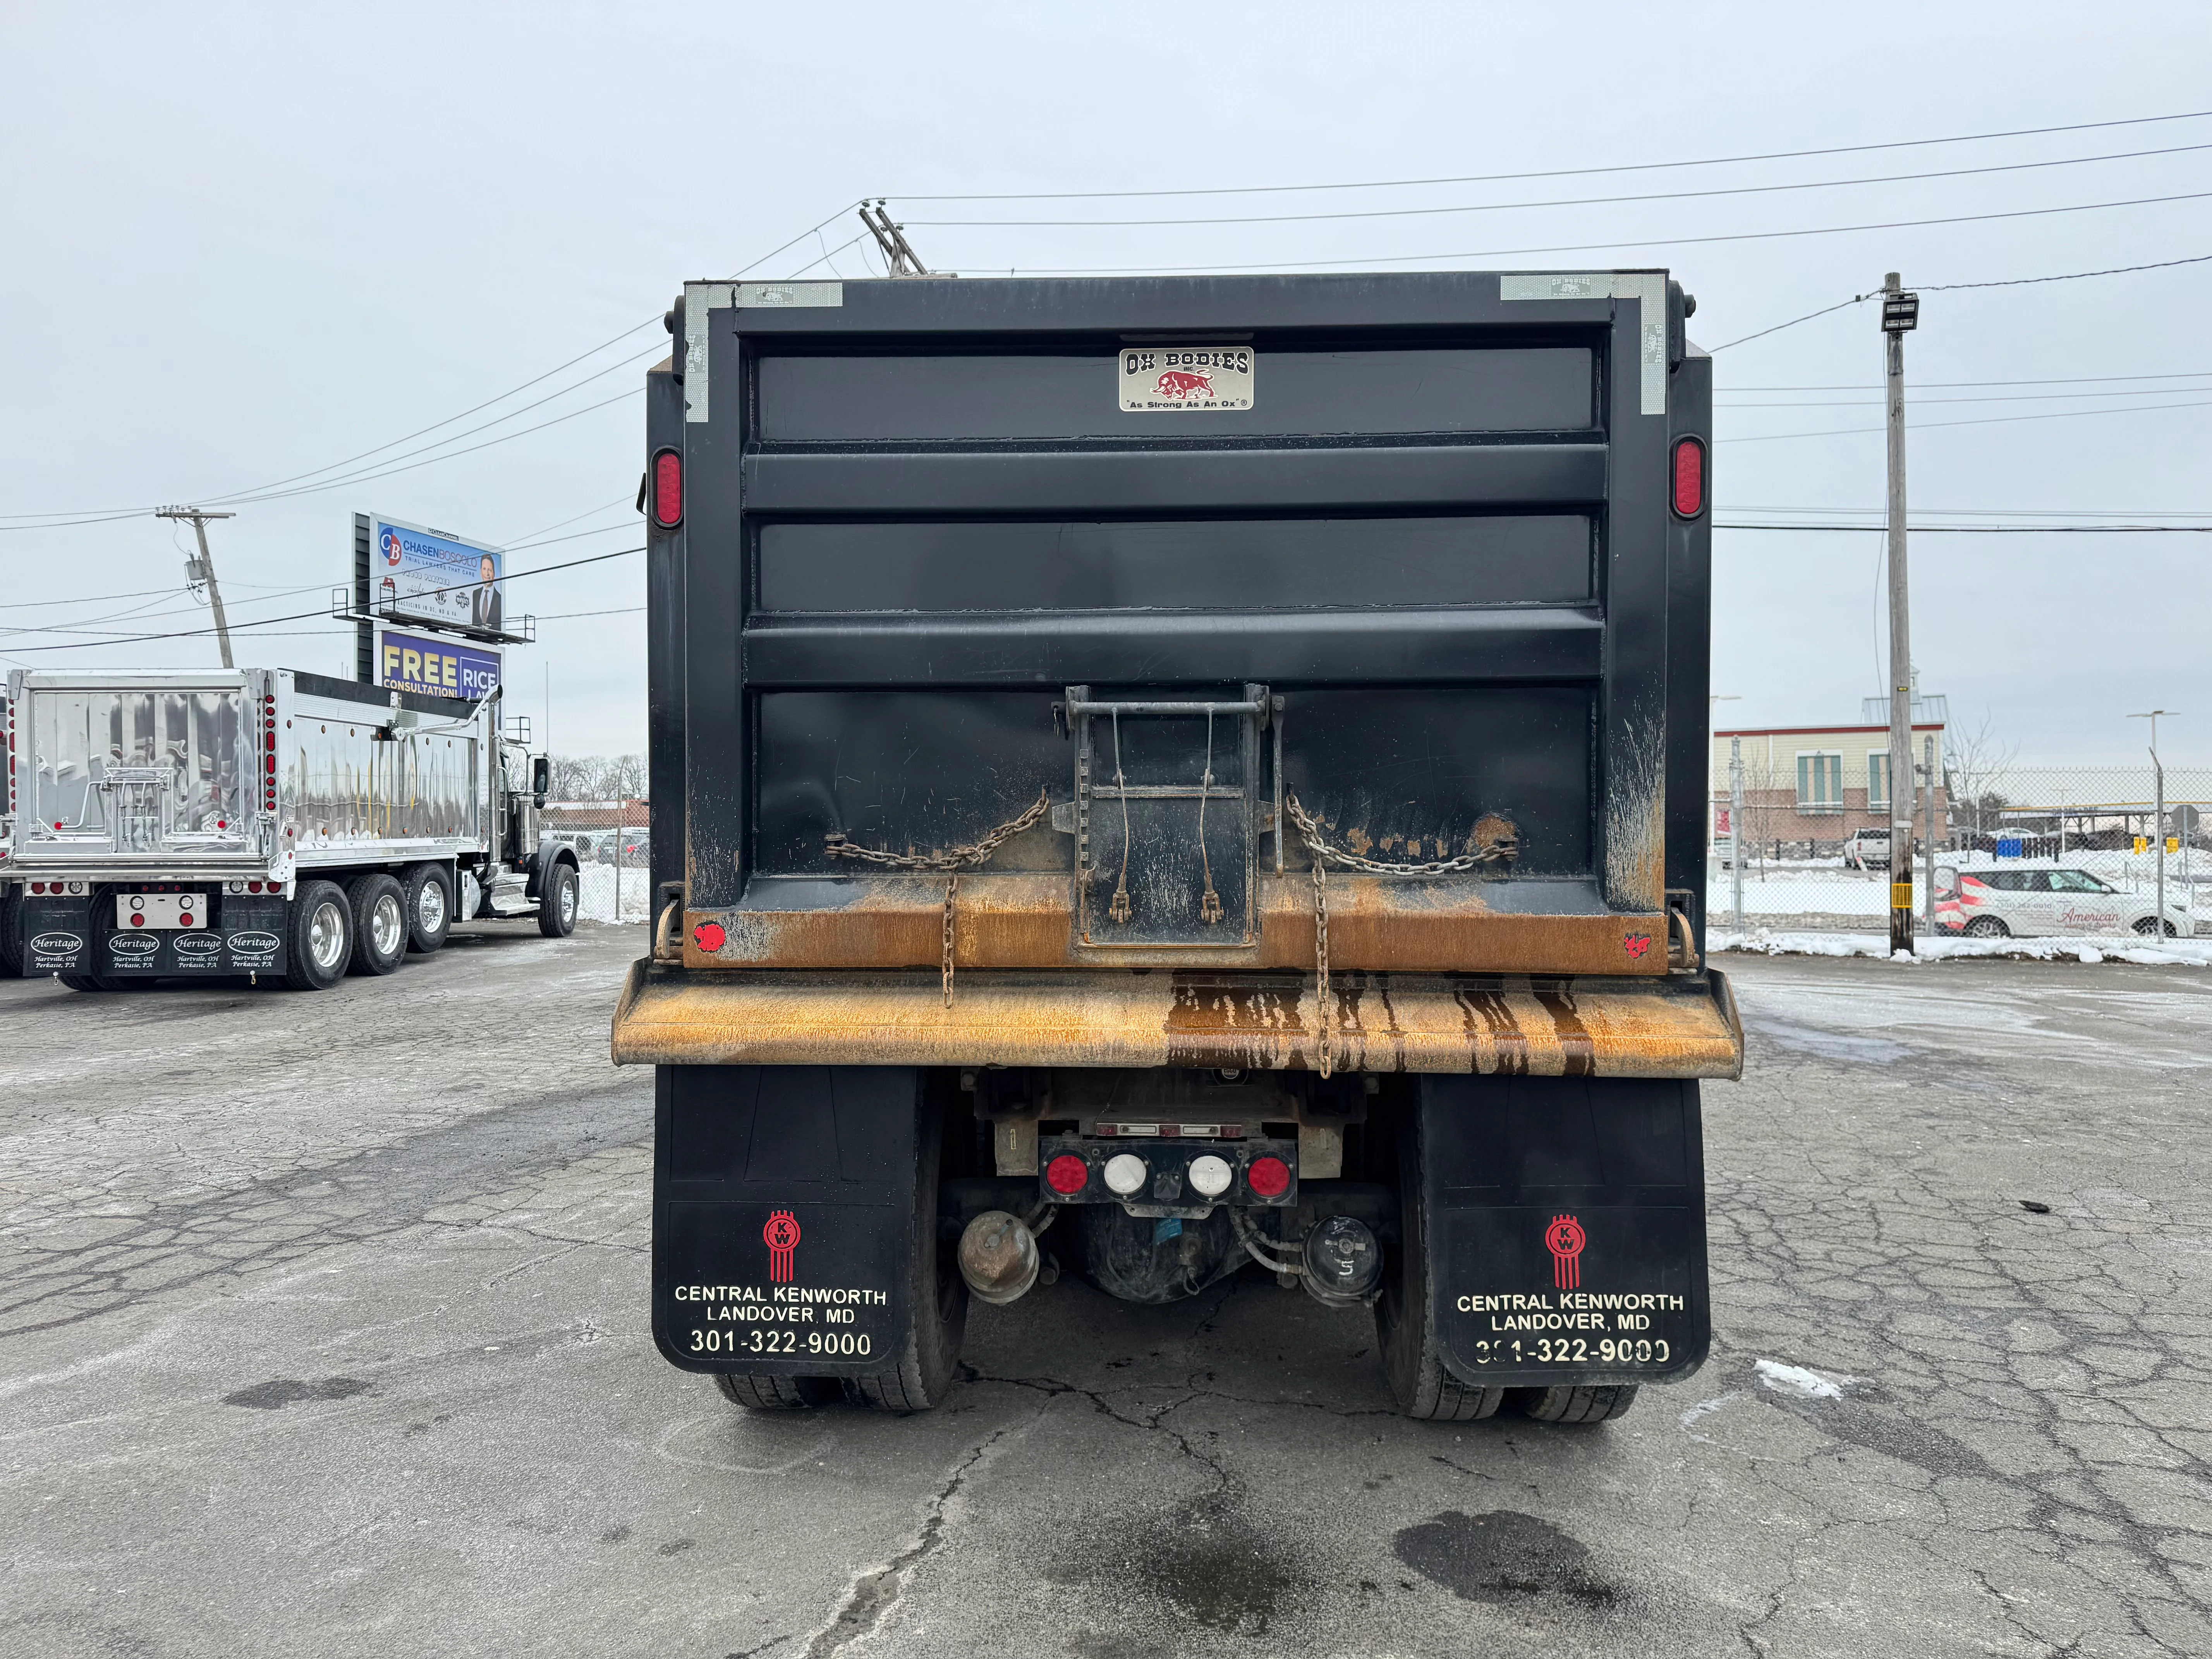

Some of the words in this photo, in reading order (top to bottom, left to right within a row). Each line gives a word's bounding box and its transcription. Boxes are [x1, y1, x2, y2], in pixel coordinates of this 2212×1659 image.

[1125, 353, 1156, 376] OX
[1164, 352, 1249, 375] BODIES
[405, 556, 420, 564] TRIAL
[422, 559, 446, 570] LAWYERS
[462, 569, 475, 577] CARE
[402, 568, 422, 579] PROUD
[424, 574, 450, 586] PARTNER
[384, 645, 457, 687] FREE
[463, 668, 496, 689] RICE
[383, 678, 457, 698] CONSULTATION!
[2057, 907, 2120, 923] American
[34, 938, 79, 950] Heritage
[112, 939, 156, 950] Heritage
[177, 938, 221, 950] Heritage
[232, 937, 276, 949] Heritage
[778, 1222, 787, 1233] K
[1560, 1227, 1570, 1238] K
[774, 1234, 791, 1245] W
[1557, 1239, 1574, 1250] W
[675, 1286, 767, 1302] CENTRAL
[774, 1287, 886, 1305] KENWORTH
[1457, 1294, 1553, 1312] CENTRAL
[1560, 1293, 1683, 1311] KENWORTH
[826, 1309, 855, 1324] MD
[1492, 1313, 1611, 1332] LANDOVER,
[1618, 1314, 1650, 1330] MD
[690, 1329, 871, 1355] 301-322-9000
